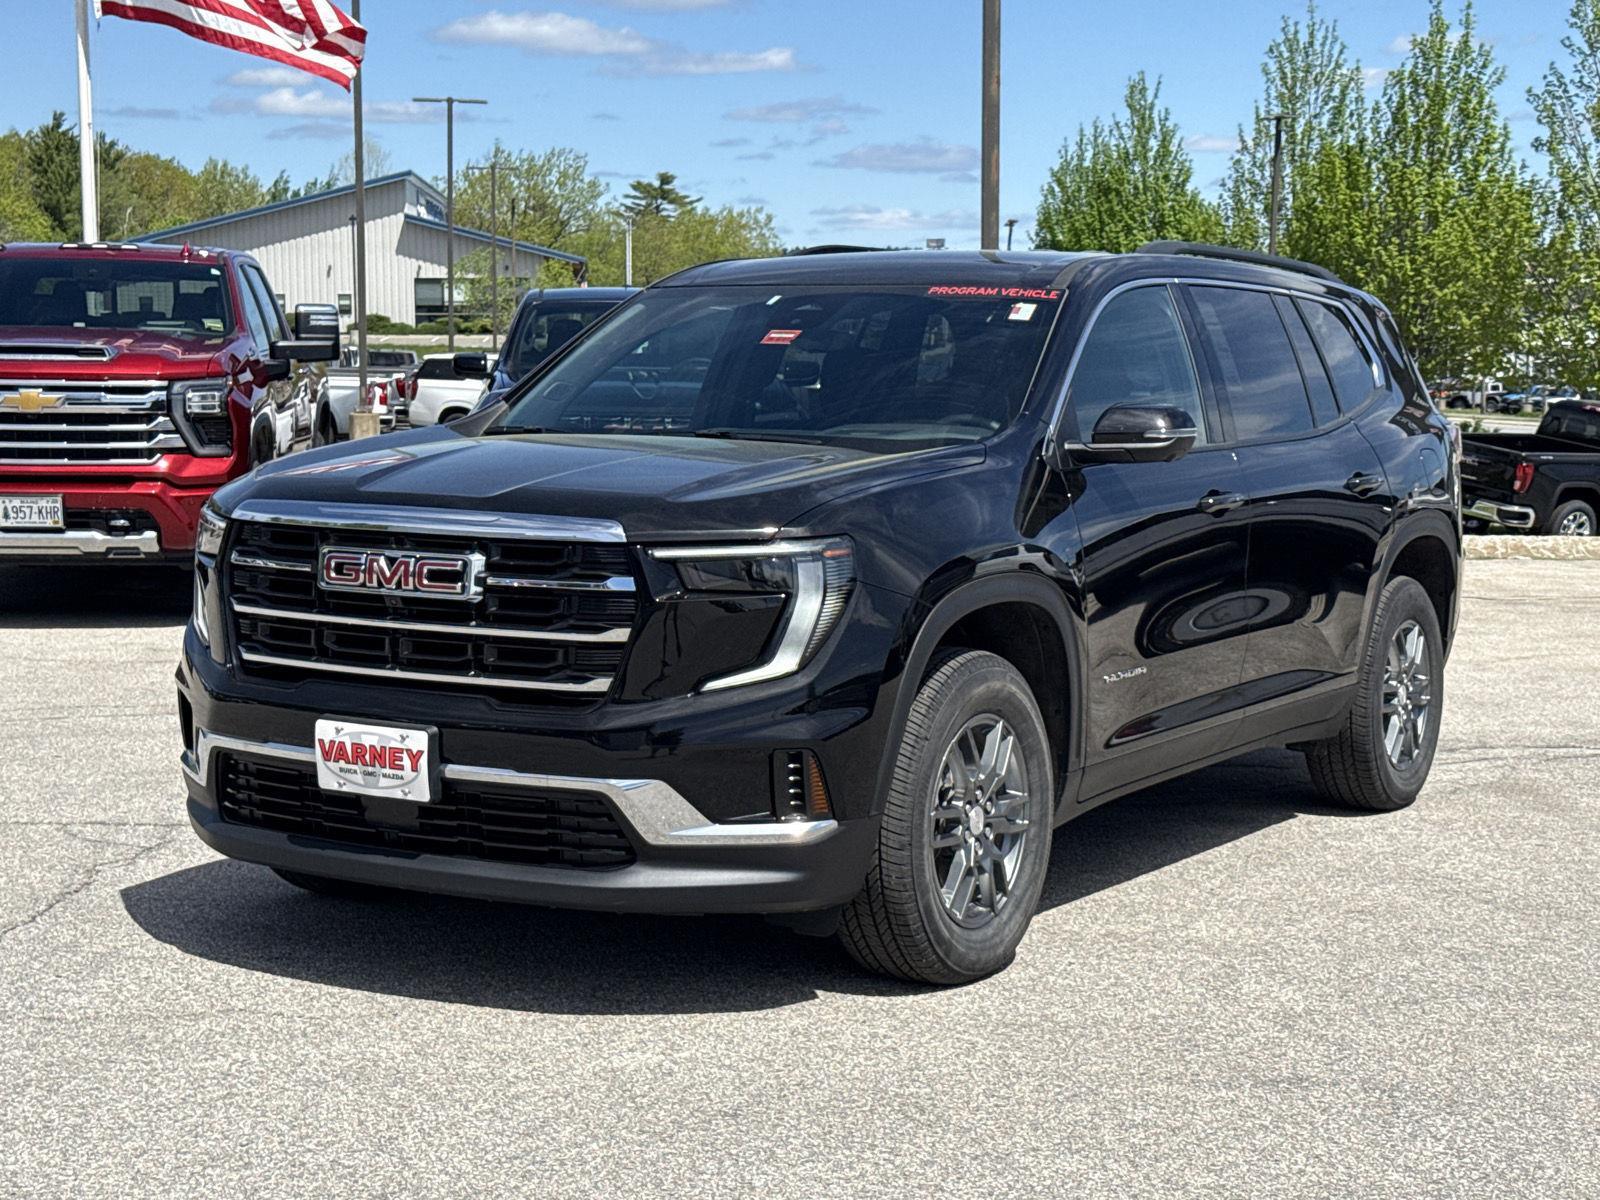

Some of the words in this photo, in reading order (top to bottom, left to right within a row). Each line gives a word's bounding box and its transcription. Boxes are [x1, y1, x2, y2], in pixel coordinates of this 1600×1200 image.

[928, 286, 998, 296] PROGRAM
[1001, 287, 1060, 299] VEHICLE
[324, 552, 463, 594] GMC
[318, 738, 424, 773] VARNEY
